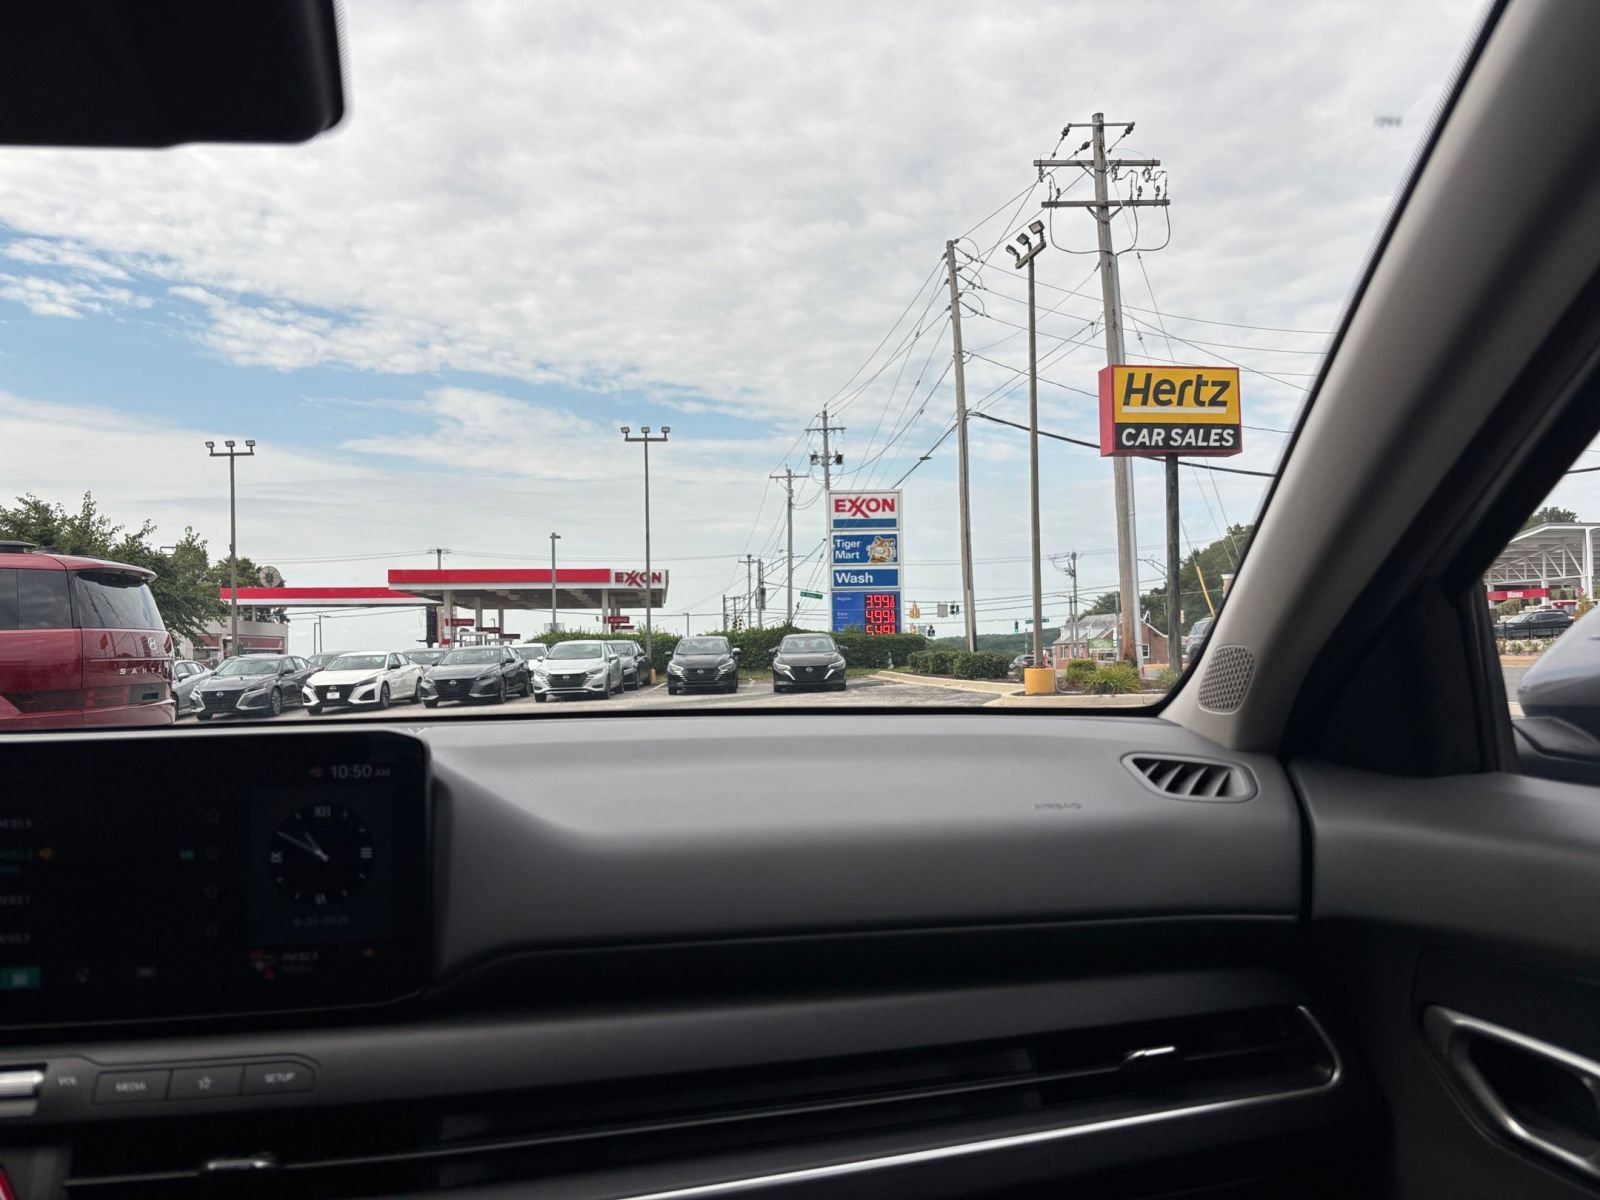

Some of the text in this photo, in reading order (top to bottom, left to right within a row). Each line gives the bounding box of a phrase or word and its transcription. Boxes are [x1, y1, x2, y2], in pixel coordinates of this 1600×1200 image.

[1122, 372, 1231, 407] Hertz
[1121, 427, 1235, 447] CAR SALES
[834, 496, 896, 519] EXXON
[835, 539, 862, 550] Tiger
[835, 550, 861, 560] Mart
[835, 572, 874, 584] Wash
[330, 763, 392, 779] 10:50 AM
